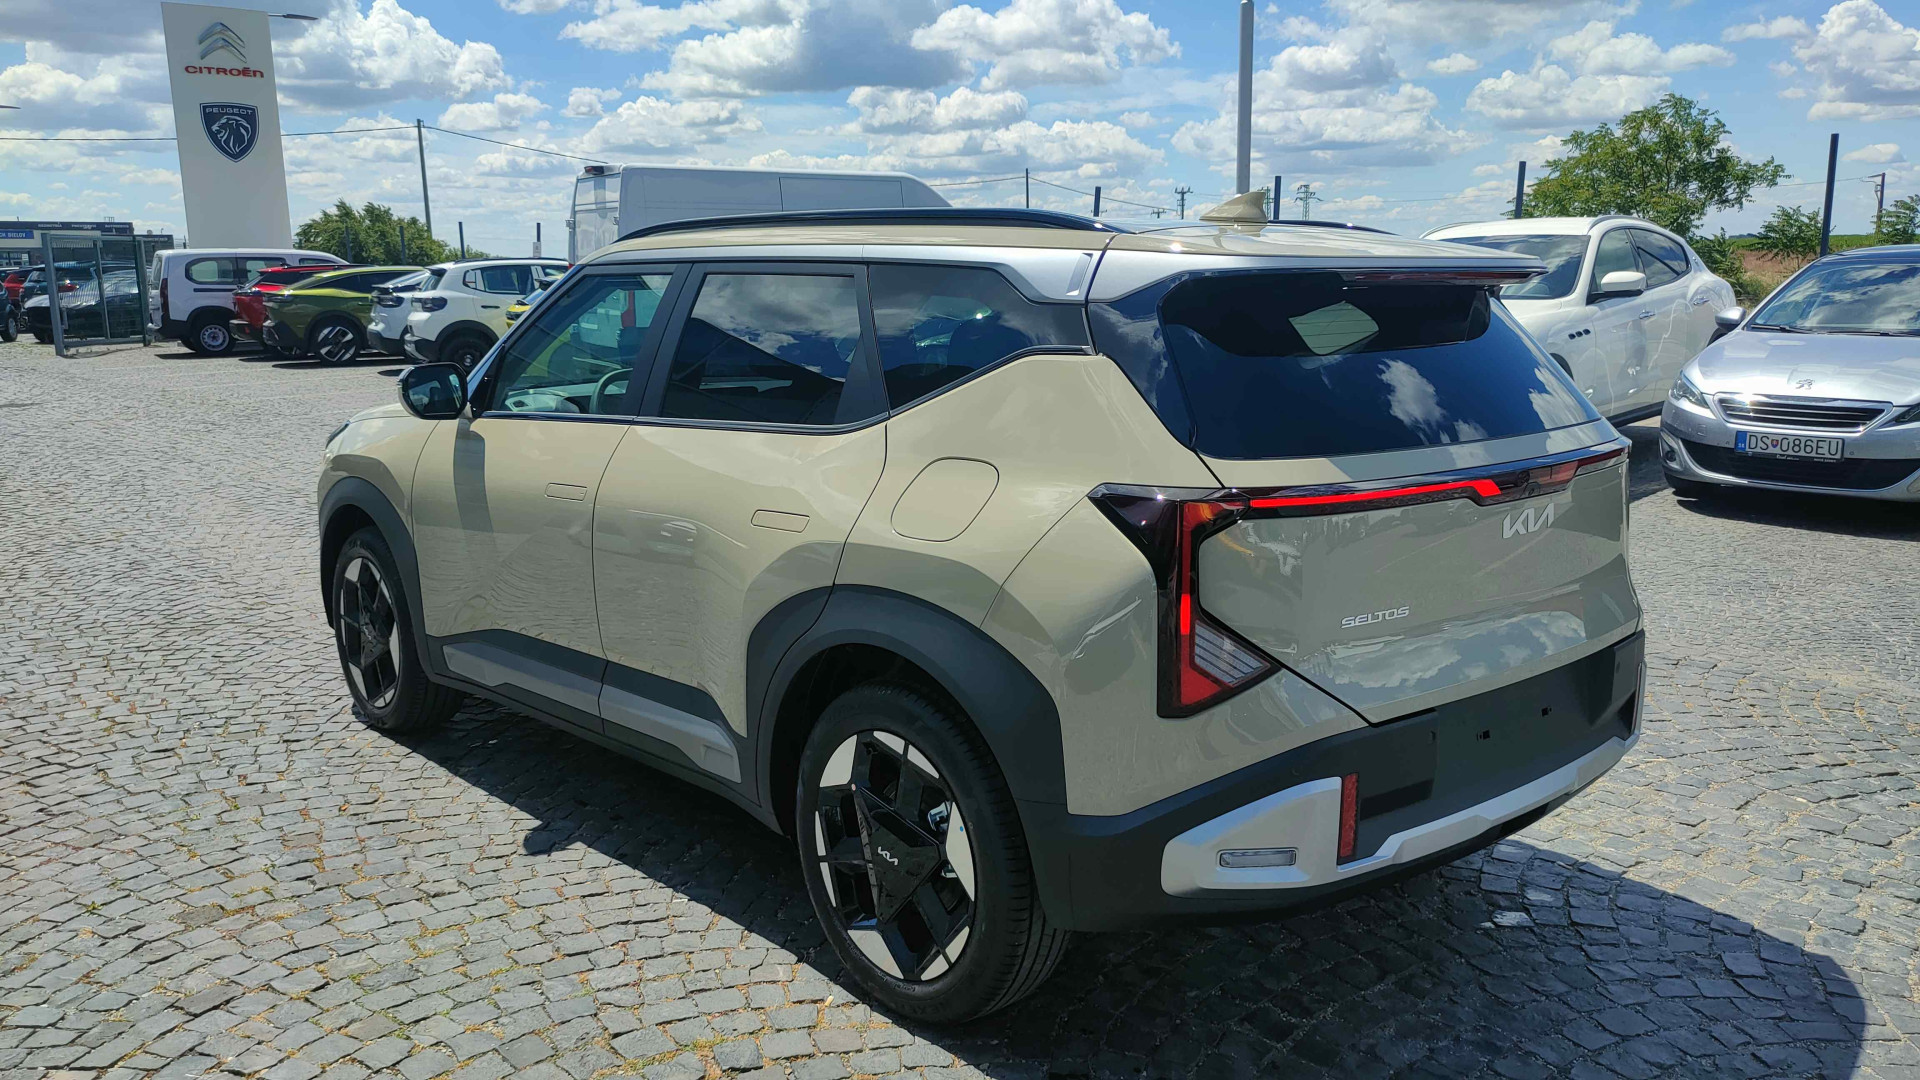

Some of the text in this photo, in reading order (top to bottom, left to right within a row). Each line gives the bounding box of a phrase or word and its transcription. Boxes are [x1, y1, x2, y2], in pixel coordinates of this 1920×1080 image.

[205, 107, 253, 115] PEUGEOT
[1748, 434, 1839, 456] DS 086EU
[1502, 502, 1555, 539] KIA
[1341, 605, 1410, 629] SELTOS
